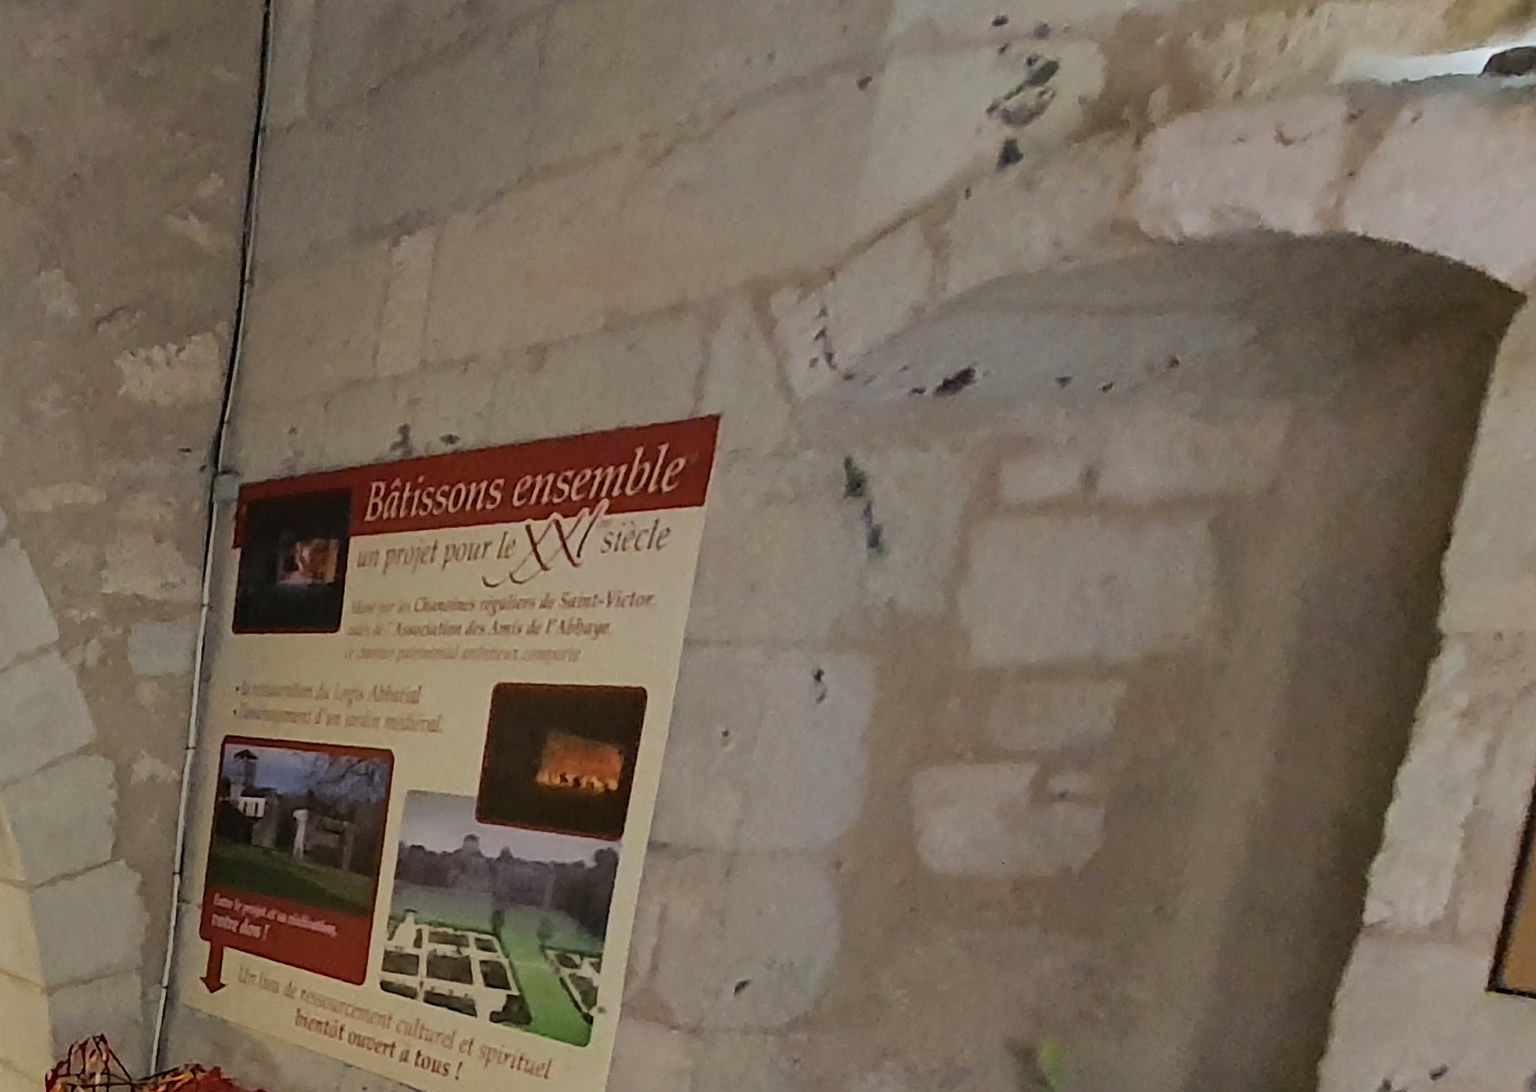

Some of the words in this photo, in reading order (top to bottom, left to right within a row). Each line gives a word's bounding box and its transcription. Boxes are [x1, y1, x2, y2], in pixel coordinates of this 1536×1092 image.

[364, 475, 506, 522] Bâtissons
[512, 442, 686, 507] ensemble
[356, 550, 381, 569] un
[382, 537, 439, 575] projet
[441, 538, 492, 573] pour
[496, 530, 517, 560] le
[600, 517, 671, 554] siècle
[237, 962, 257, 986] Un
[282, 979, 296, 1001] de
[299, 987, 395, 1031] ressourcement
[396, 1011, 457, 1051] culturel
[458, 1035, 475, 1057] et
[478, 1041, 553, 1080] spirituel
[294, 1008, 345, 1041] bientôt
[347, 1029, 398, 1059] ouvert
[399, 1039, 412, 1064] à
[413, 1049, 452, 1078] tous
[454, 1061, 464, 1081] !
